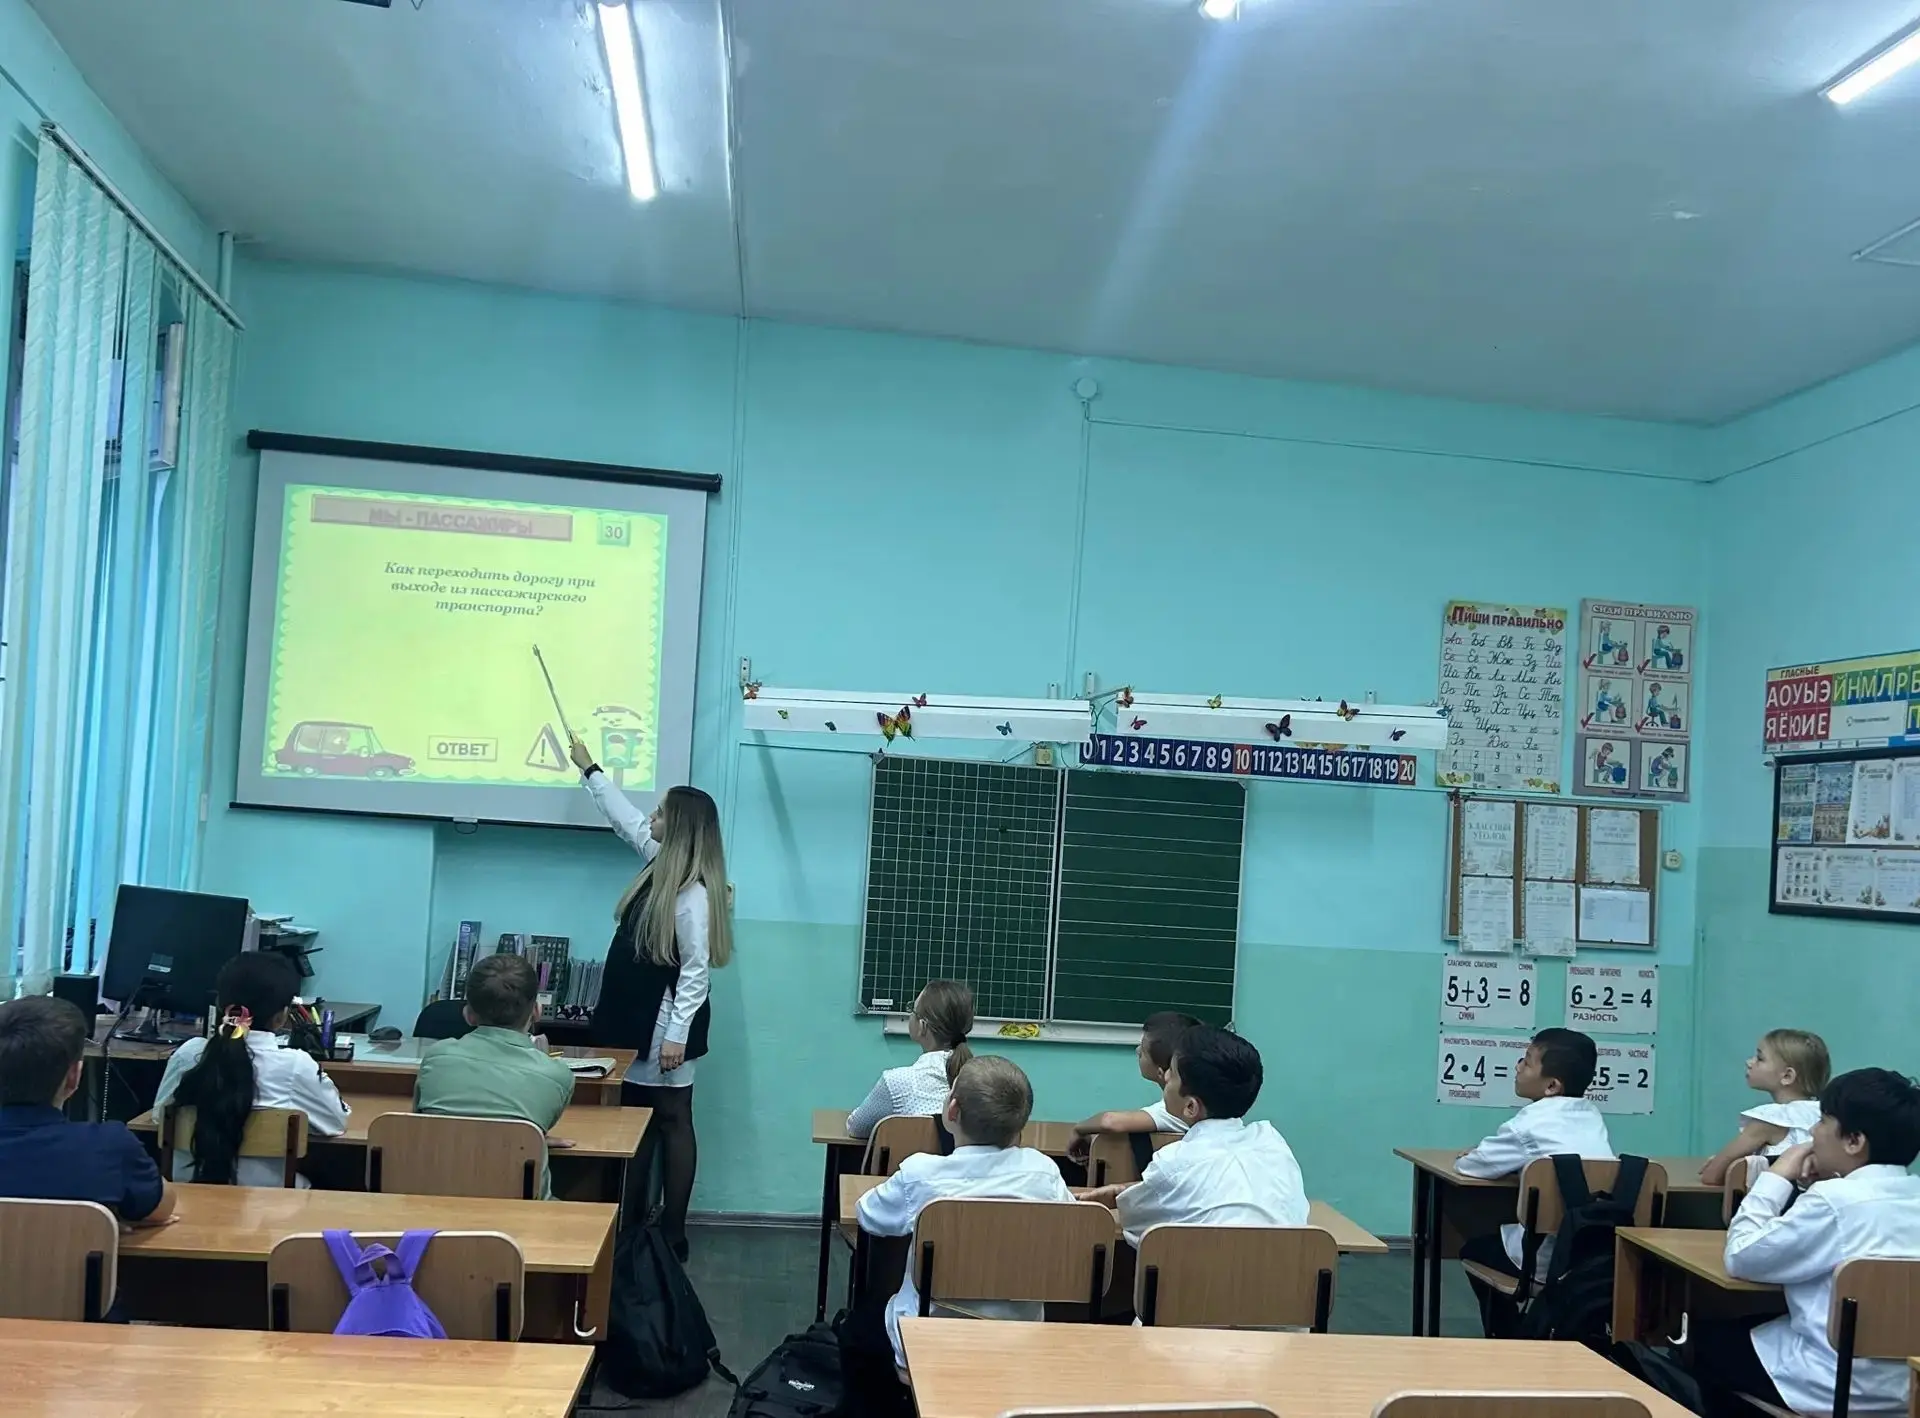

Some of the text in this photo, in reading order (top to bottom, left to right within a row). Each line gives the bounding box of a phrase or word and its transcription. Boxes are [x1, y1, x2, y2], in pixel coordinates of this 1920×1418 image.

[415, 510, 533, 534] ПАССАЖИРЫ
[605, 525, 624, 540] 30
[384, 561, 596, 589] Как переходить дорогу при
[391, 580, 587, 606] выходе из пассажирского
[435, 598, 544, 618] транспорта?
[1624, 607, 1693, 620] ПРАВИЛЬНО
[1492, 614, 1564, 631] ПРАВИЛЬНО
[1779, 665, 1820, 679] ГЛАСНЫЕ
[436, 742, 490, 756] ОТВЕТ
[1083, 739, 1415, 781] 0 1 2 3 4 5 6 7 8 9 10 11 12 13 14 15 16 17 18 19 20
[1519, 979, 1530, 1006] 8
[1640, 988, 1653, 1008] 4
[1572, 1012, 1618, 1022] РАЗНОСТЬ
[1637, 1068, 1649, 1088] 2
[1584, 1093, 1609, 1102] ТНОЕ
